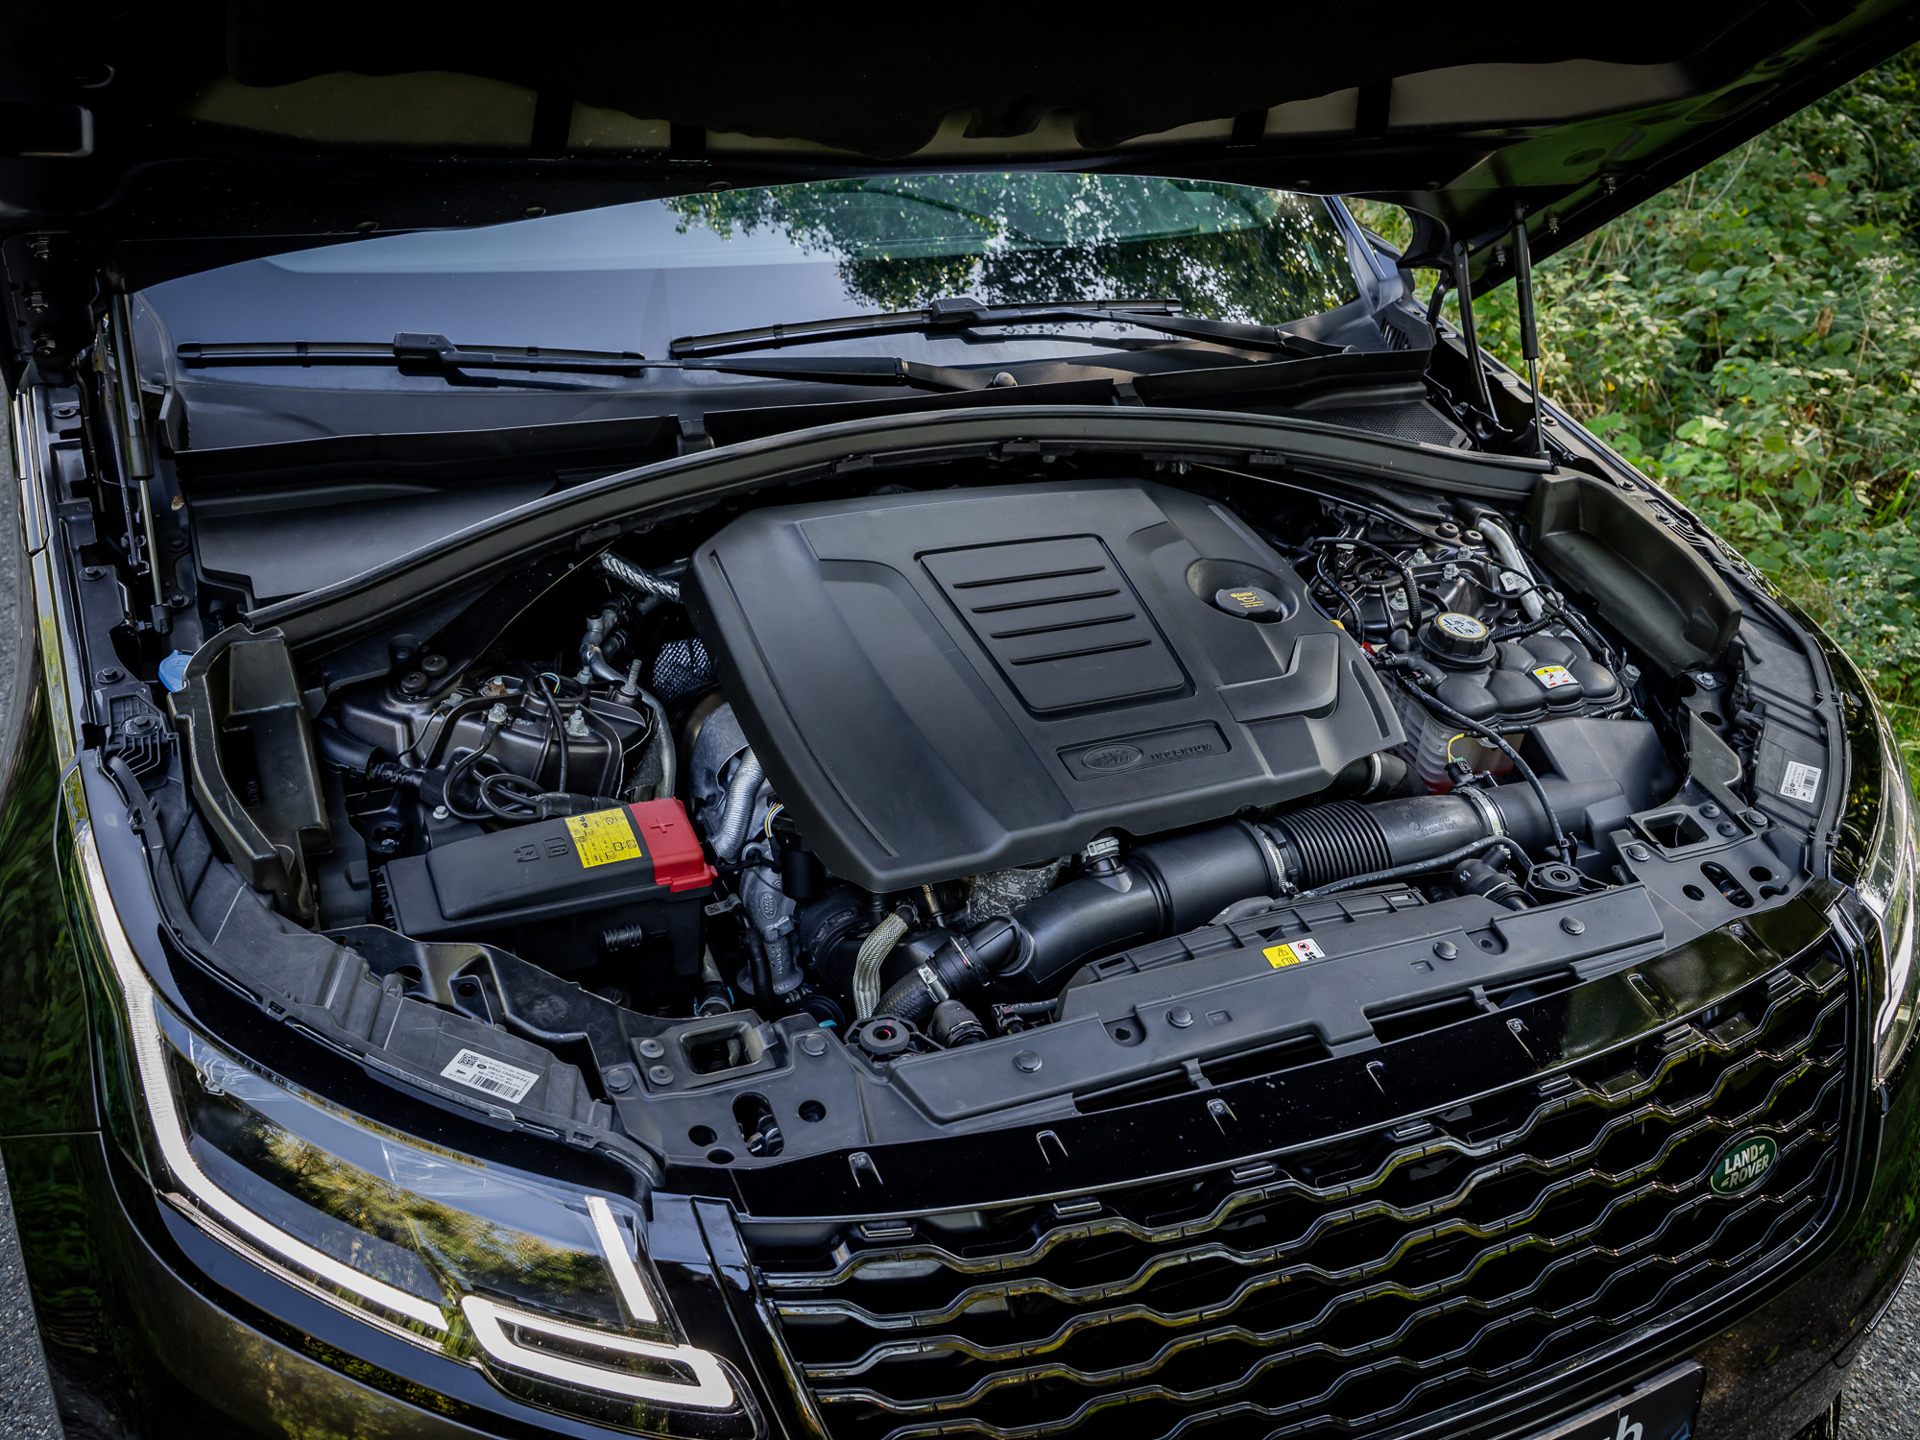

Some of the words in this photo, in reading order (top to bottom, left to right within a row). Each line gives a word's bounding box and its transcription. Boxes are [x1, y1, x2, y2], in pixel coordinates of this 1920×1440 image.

[1150, 743, 1213, 761] INGENIUM
[1725, 1144, 1759, 1175] LAND
[1729, 1154, 1769, 1188] ROVER
